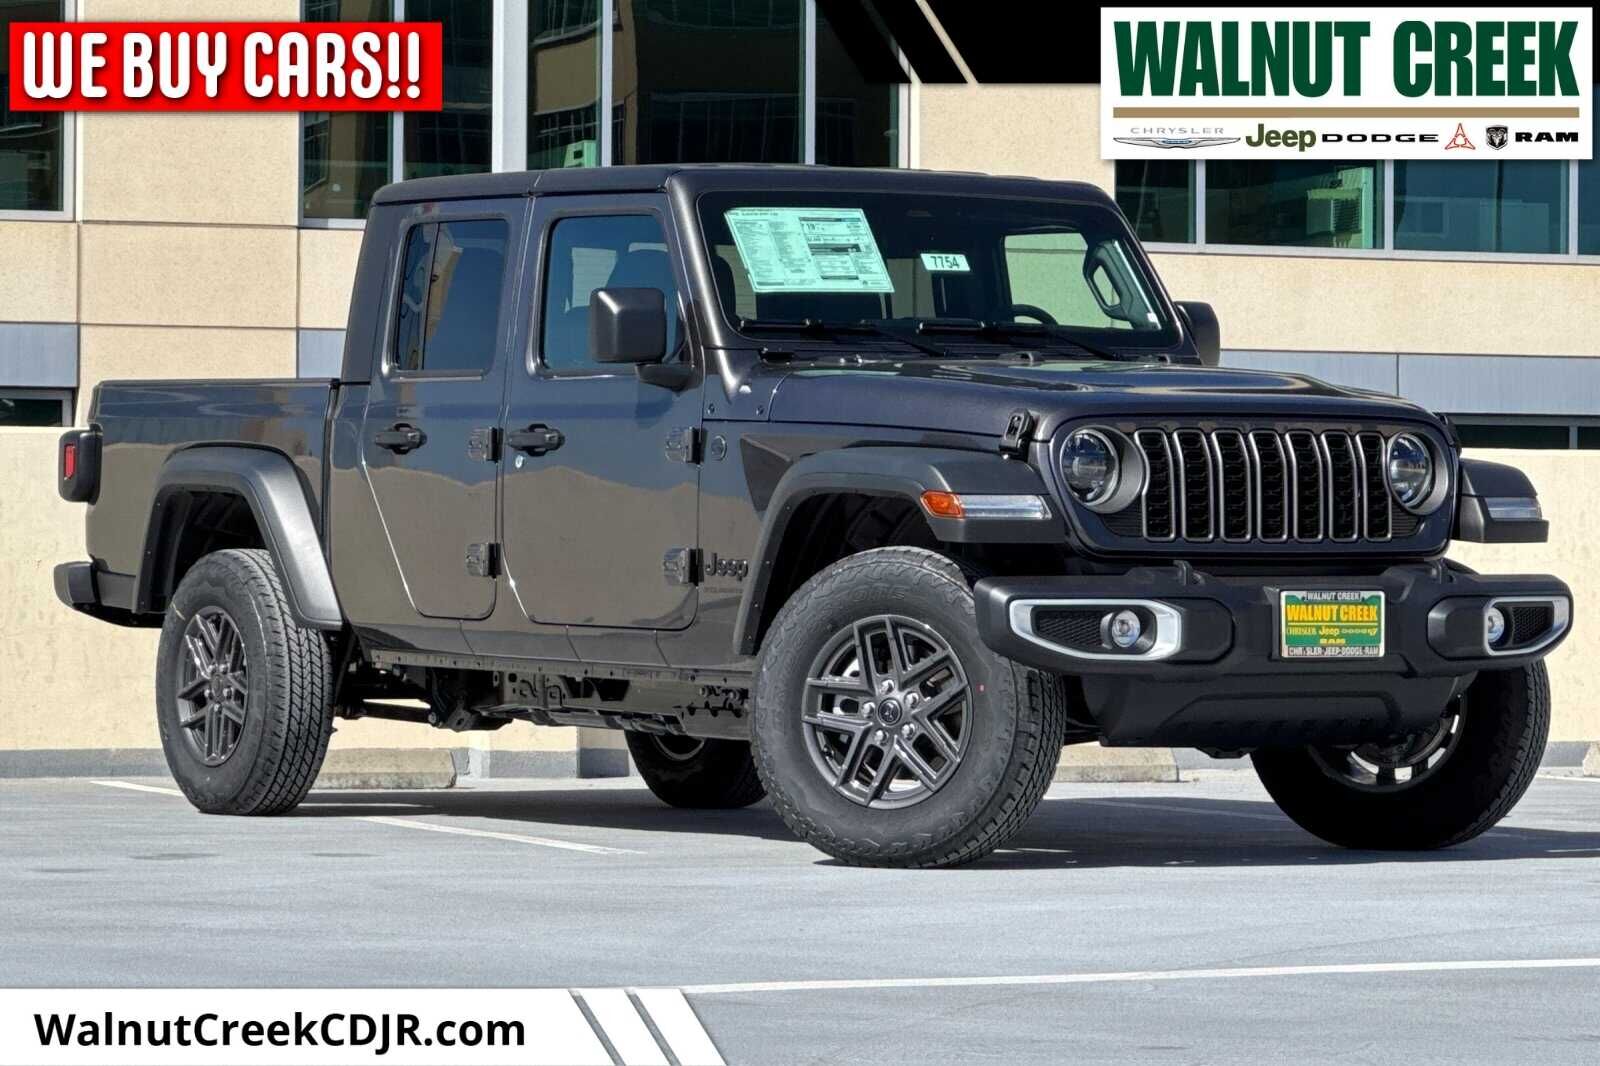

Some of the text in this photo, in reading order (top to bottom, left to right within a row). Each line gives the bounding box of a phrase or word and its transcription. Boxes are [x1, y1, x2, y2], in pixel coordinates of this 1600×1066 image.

[930, 256, 960, 269] 7754
[705, 552, 749, 582] Jeep
[1307, 592, 1360, 601] WALNUT CREEK
[1287, 604, 1378, 621] WALNUT CREEK
[1319, 626, 1340, 636] Jeep
